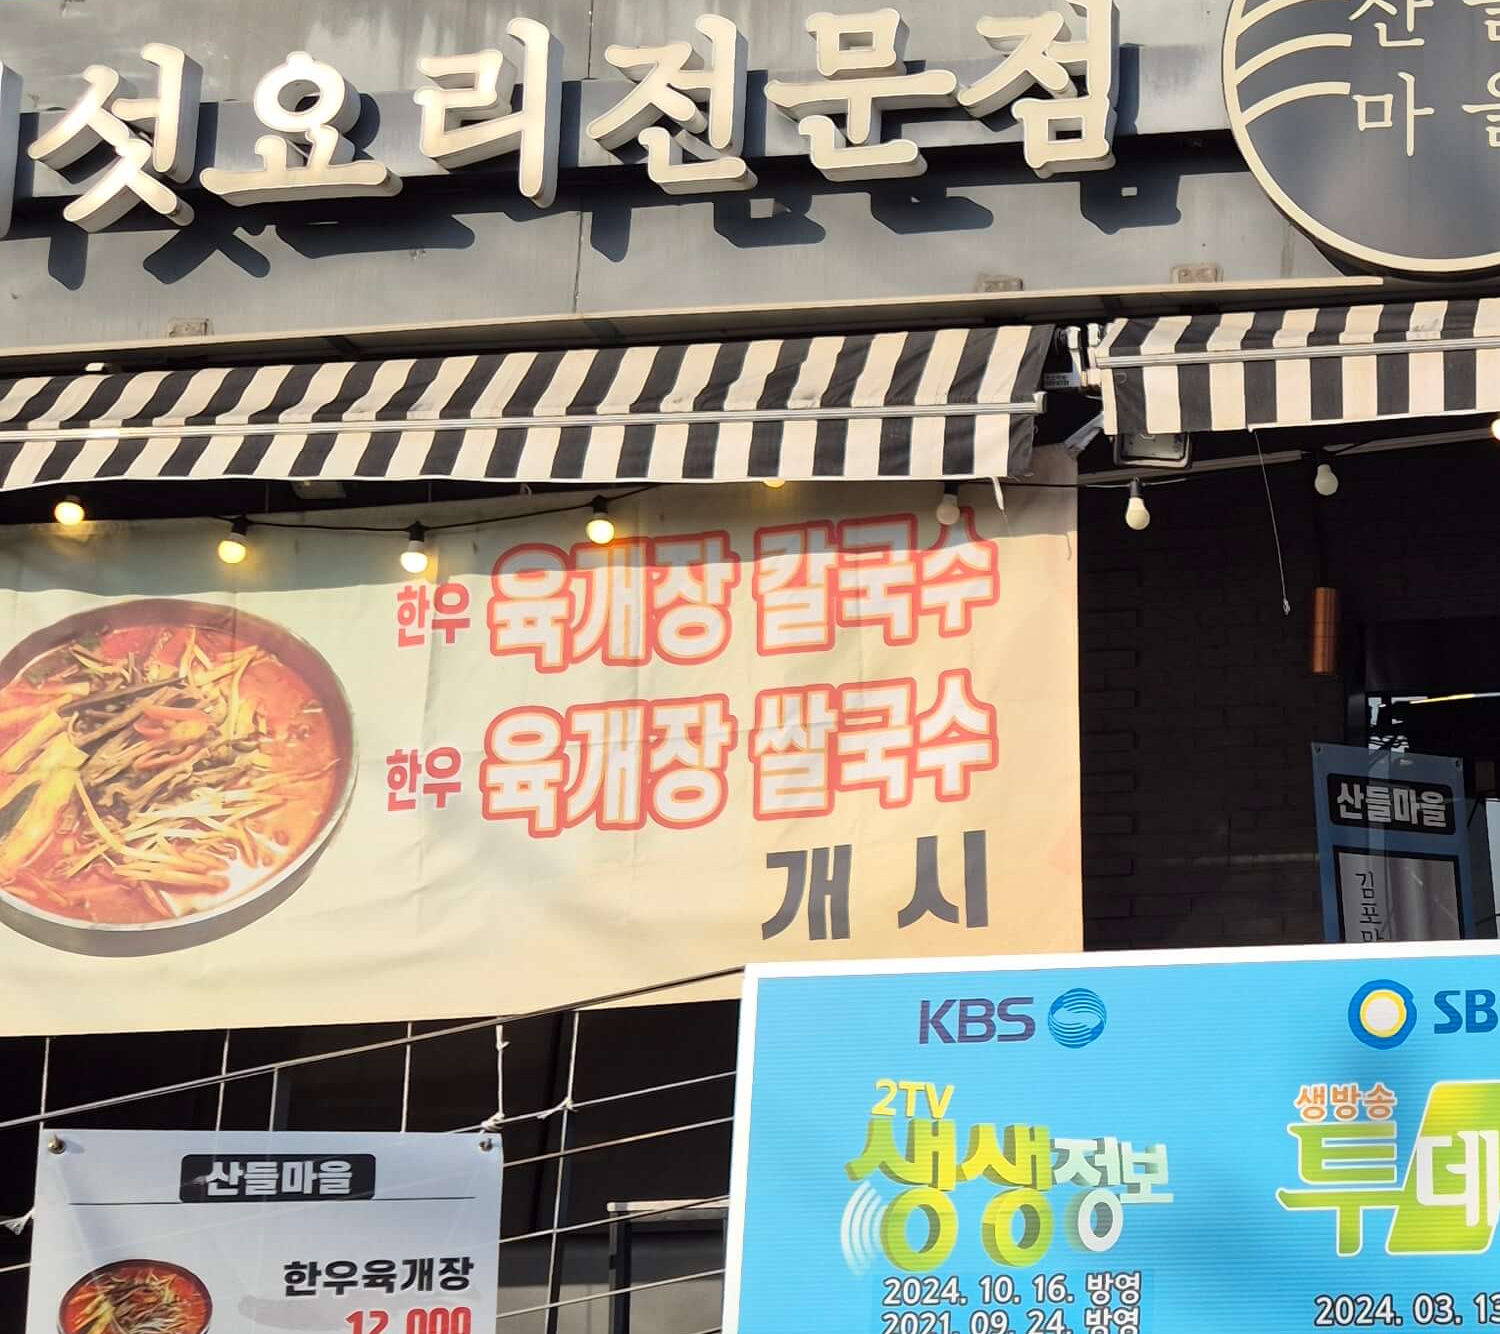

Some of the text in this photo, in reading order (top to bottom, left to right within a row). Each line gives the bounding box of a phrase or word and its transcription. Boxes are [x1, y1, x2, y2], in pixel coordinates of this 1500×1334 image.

[396, 507, 999, 674] 한우 육개장 칼국수
[386, 668, 999, 838] 한우 육개장 쌀국수
[1337, 782, 1447, 828] 산들마을
[919, 997, 1036, 1044] KBS
[871, 1078, 954, 1119] 2TV
[1295, 1083, 1397, 1122] 생방송
[205, 1160, 353, 1196] 산들마을
[844, 1117, 1174, 1272] 생생정보
[284, 1257, 474, 1298] 한우육개장
[882, 1271, 1141, 1306] 2024. 10. 16. 방영
[1315, 1294, 1403, 1327] 2024.
[1413, 1293, 1463, 1325] 03.
